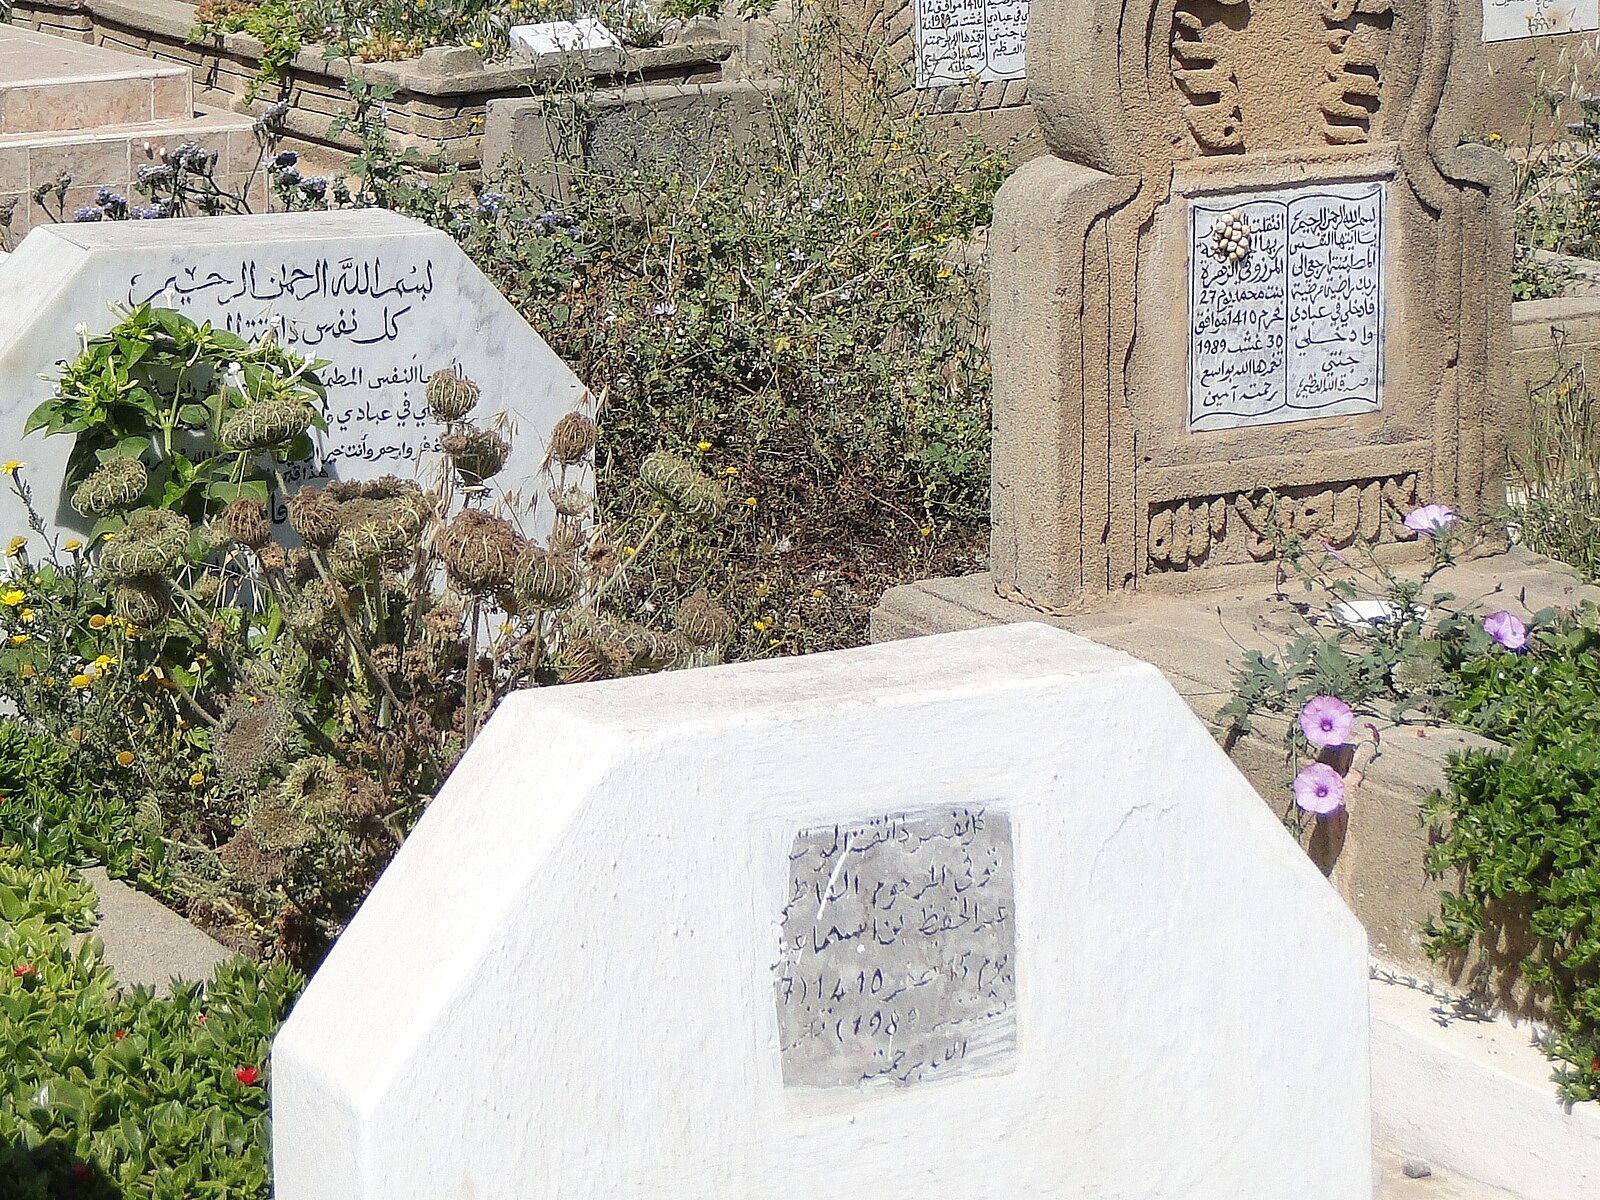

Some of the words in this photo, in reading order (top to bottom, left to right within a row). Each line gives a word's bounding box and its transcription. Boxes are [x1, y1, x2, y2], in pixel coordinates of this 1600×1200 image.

[922, 0, 934, 15] 12
[1250, 212, 1285, 235] انتقلت
[1290, 207, 1325, 236] الرحيم
[1319, 204, 1344, 231] الرحمن
[1343, 204, 1361, 223] الله
[1344, 206, 1376, 230] بسم
[1259, 234, 1285, 260] ربها
[127, 259, 248, 306] الرحيم
[250, 257, 329, 302] الرحمن
[331, 256, 382, 299] الله
[373, 257, 434, 302] بسم
[1291, 278, 1326, 303] مرضية
[1355, 275, 1376, 296] ربك
[1200, 289, 1216, 305] 27
[1215, 289, 1233, 313] يوم
[1264, 285, 1285, 305] بنت
[352, 305, 412, 344] كل
[1195, 308, 1228, 335] موافق
[1227, 310, 1257, 326] 1410
[1290, 304, 1332, 331] عبادي
[1331, 300, 1342, 327] في
[1340, 296, 1375, 328] فادخلي
[302, 308, 358, 345] نفس
[1197, 338, 1227, 355] 1989
[1266, 334, 1284, 349] 30
[1321, 350, 1361, 377] جنتي
[1239, 381, 1279, 403] رحمته
[336, 400, 393, 432] عبادي
[396, 391, 412, 428] في
